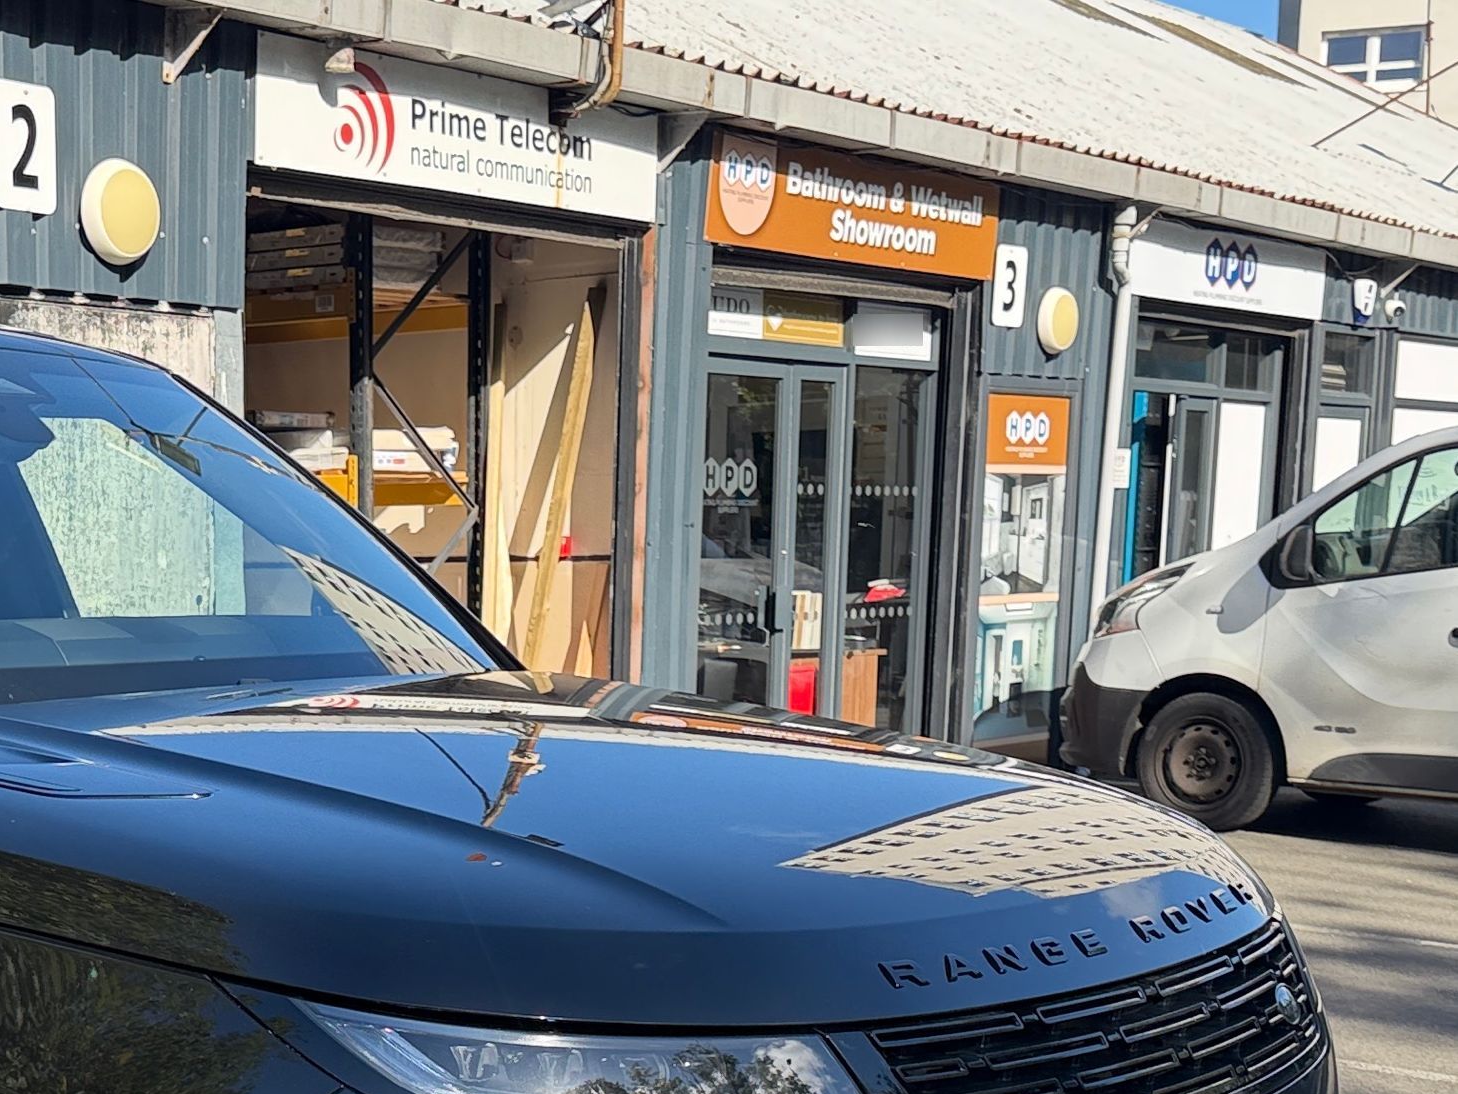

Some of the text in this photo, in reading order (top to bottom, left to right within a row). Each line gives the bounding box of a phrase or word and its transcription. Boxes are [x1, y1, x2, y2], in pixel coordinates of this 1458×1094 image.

[11, 103, 39, 190] 2
[410, 98, 592, 161] Prime Telecom
[410, 145, 592, 194] natural communication
[728, 155, 771, 185] HPD
[785, 162, 887, 211] Bathroom
[889, 181, 905, 213] &
[910, 185, 984, 227] Wetwall
[829, 208, 937, 255] Showroom
[1002, 260, 1017, 312] 3
[1207, 246, 1256, 283] HPD
[1009, 418, 1047, 438] HPD
[705, 464, 754, 489] HPD
[877, 882, 1255, 990] RANGE ROVER
